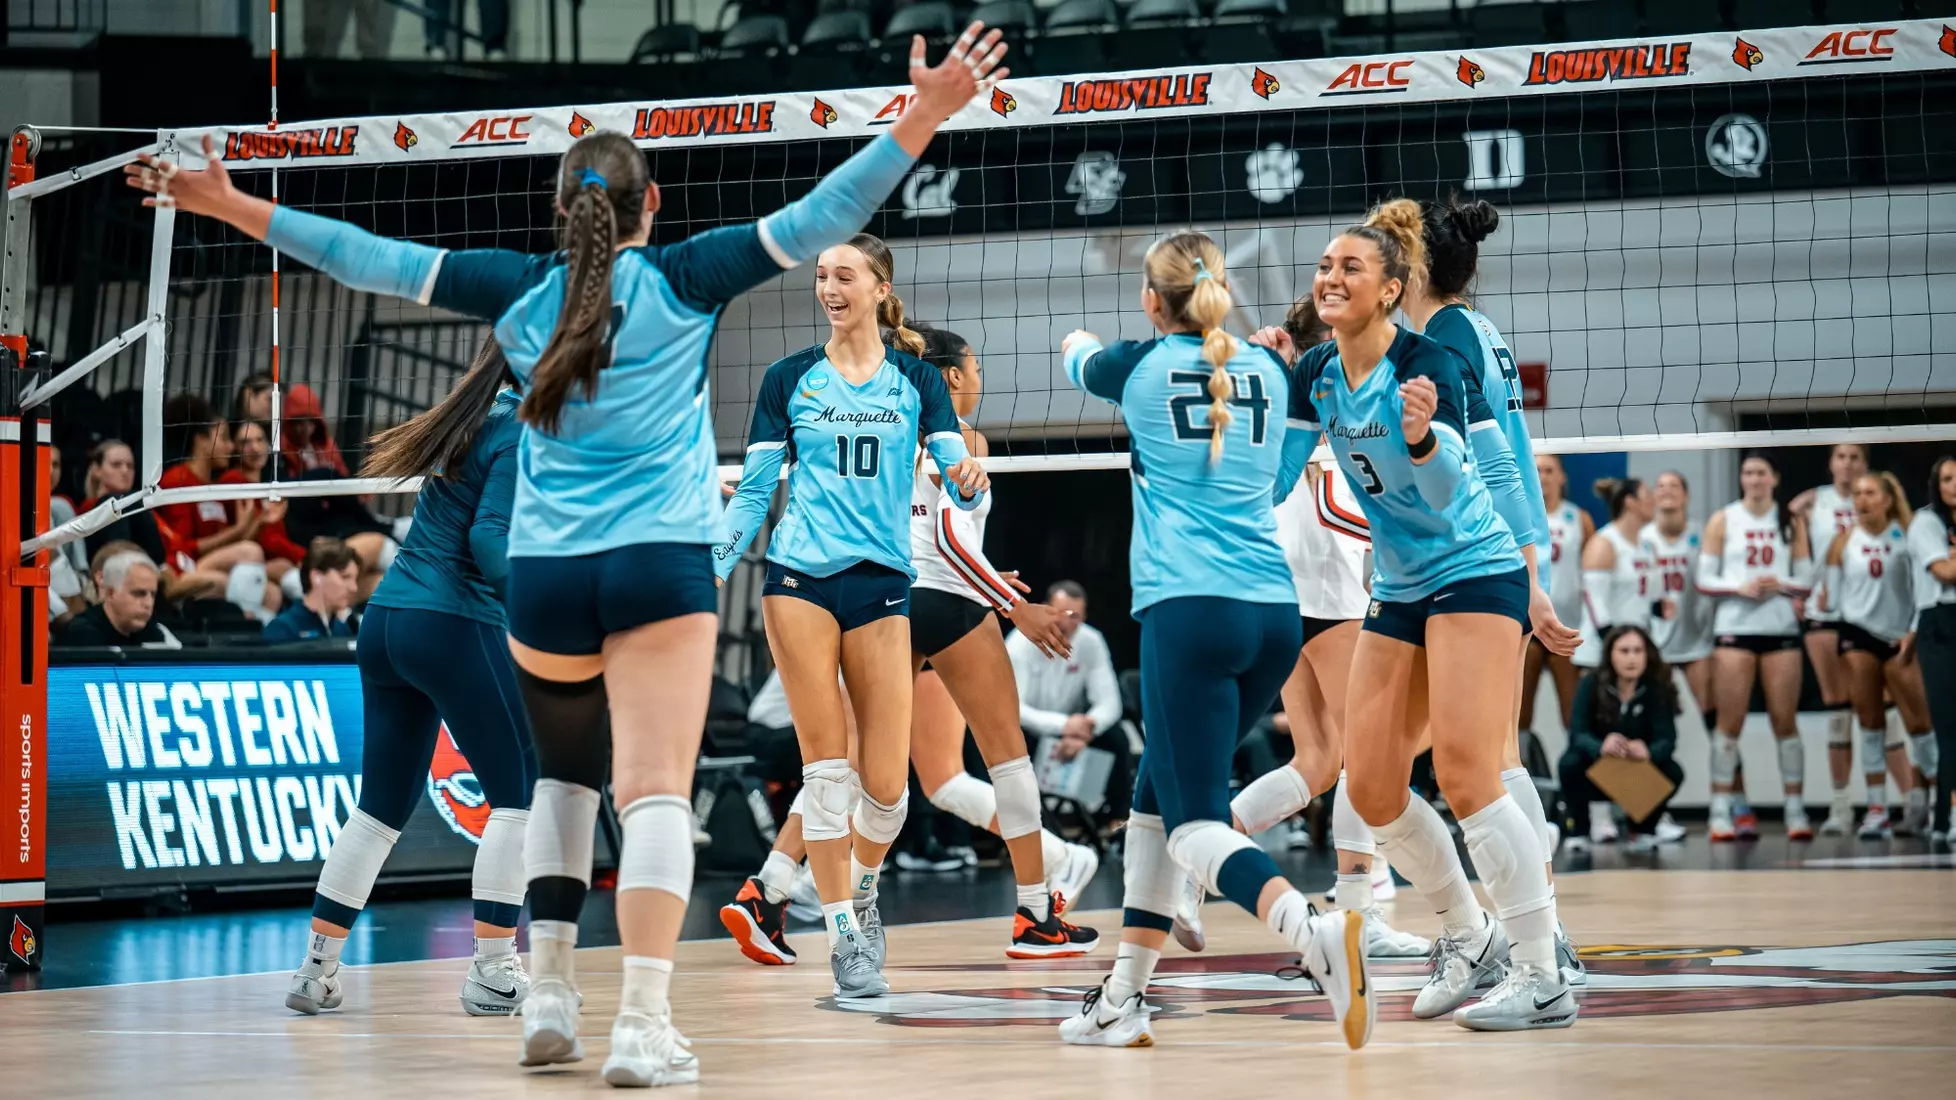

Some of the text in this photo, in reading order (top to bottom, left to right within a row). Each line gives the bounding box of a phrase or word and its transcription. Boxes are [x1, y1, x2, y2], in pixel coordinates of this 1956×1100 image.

[1803, 28, 1898, 59] ACC
[1326, 60, 1415, 90] ACC
[1521, 42, 1693, 85] LOUISVILLE
[1052, 72, 1213, 115] LOUISVILLE
[456, 116, 533, 142] ACC
[631, 100, 776, 139] LOUISVILLE
[222, 125, 360, 161] LOUISVILLE
[814, 406, 902, 428] Marquette
[1168, 369, 1271, 447] 24
[1326, 415, 1390, 446] Marquette
[835, 433, 881, 479] 10
[1349, 452, 1386, 496] 3
[1746, 544, 1774, 566] 20
[1869, 558, 1882, 579] 0
[84, 680, 341, 770] WESTERN
[19, 713, 32, 863] sports imports
